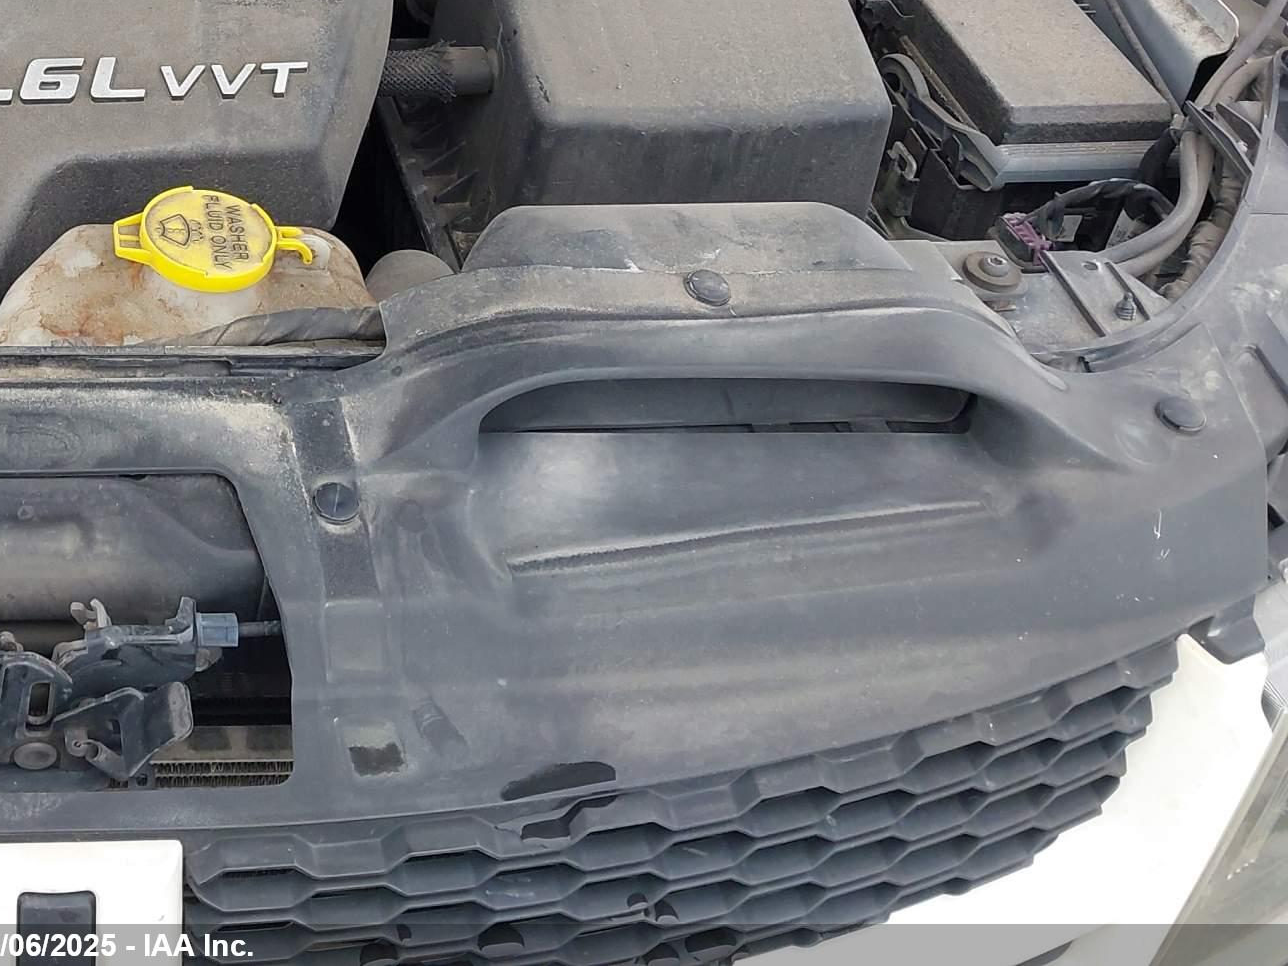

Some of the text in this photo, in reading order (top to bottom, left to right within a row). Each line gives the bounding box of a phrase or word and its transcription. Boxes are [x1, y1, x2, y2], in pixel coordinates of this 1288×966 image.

[160, 62, 309, 100] VVT
[203, 194, 233, 270] FLUID ONLY
[225, 204, 250, 261] WASHER
